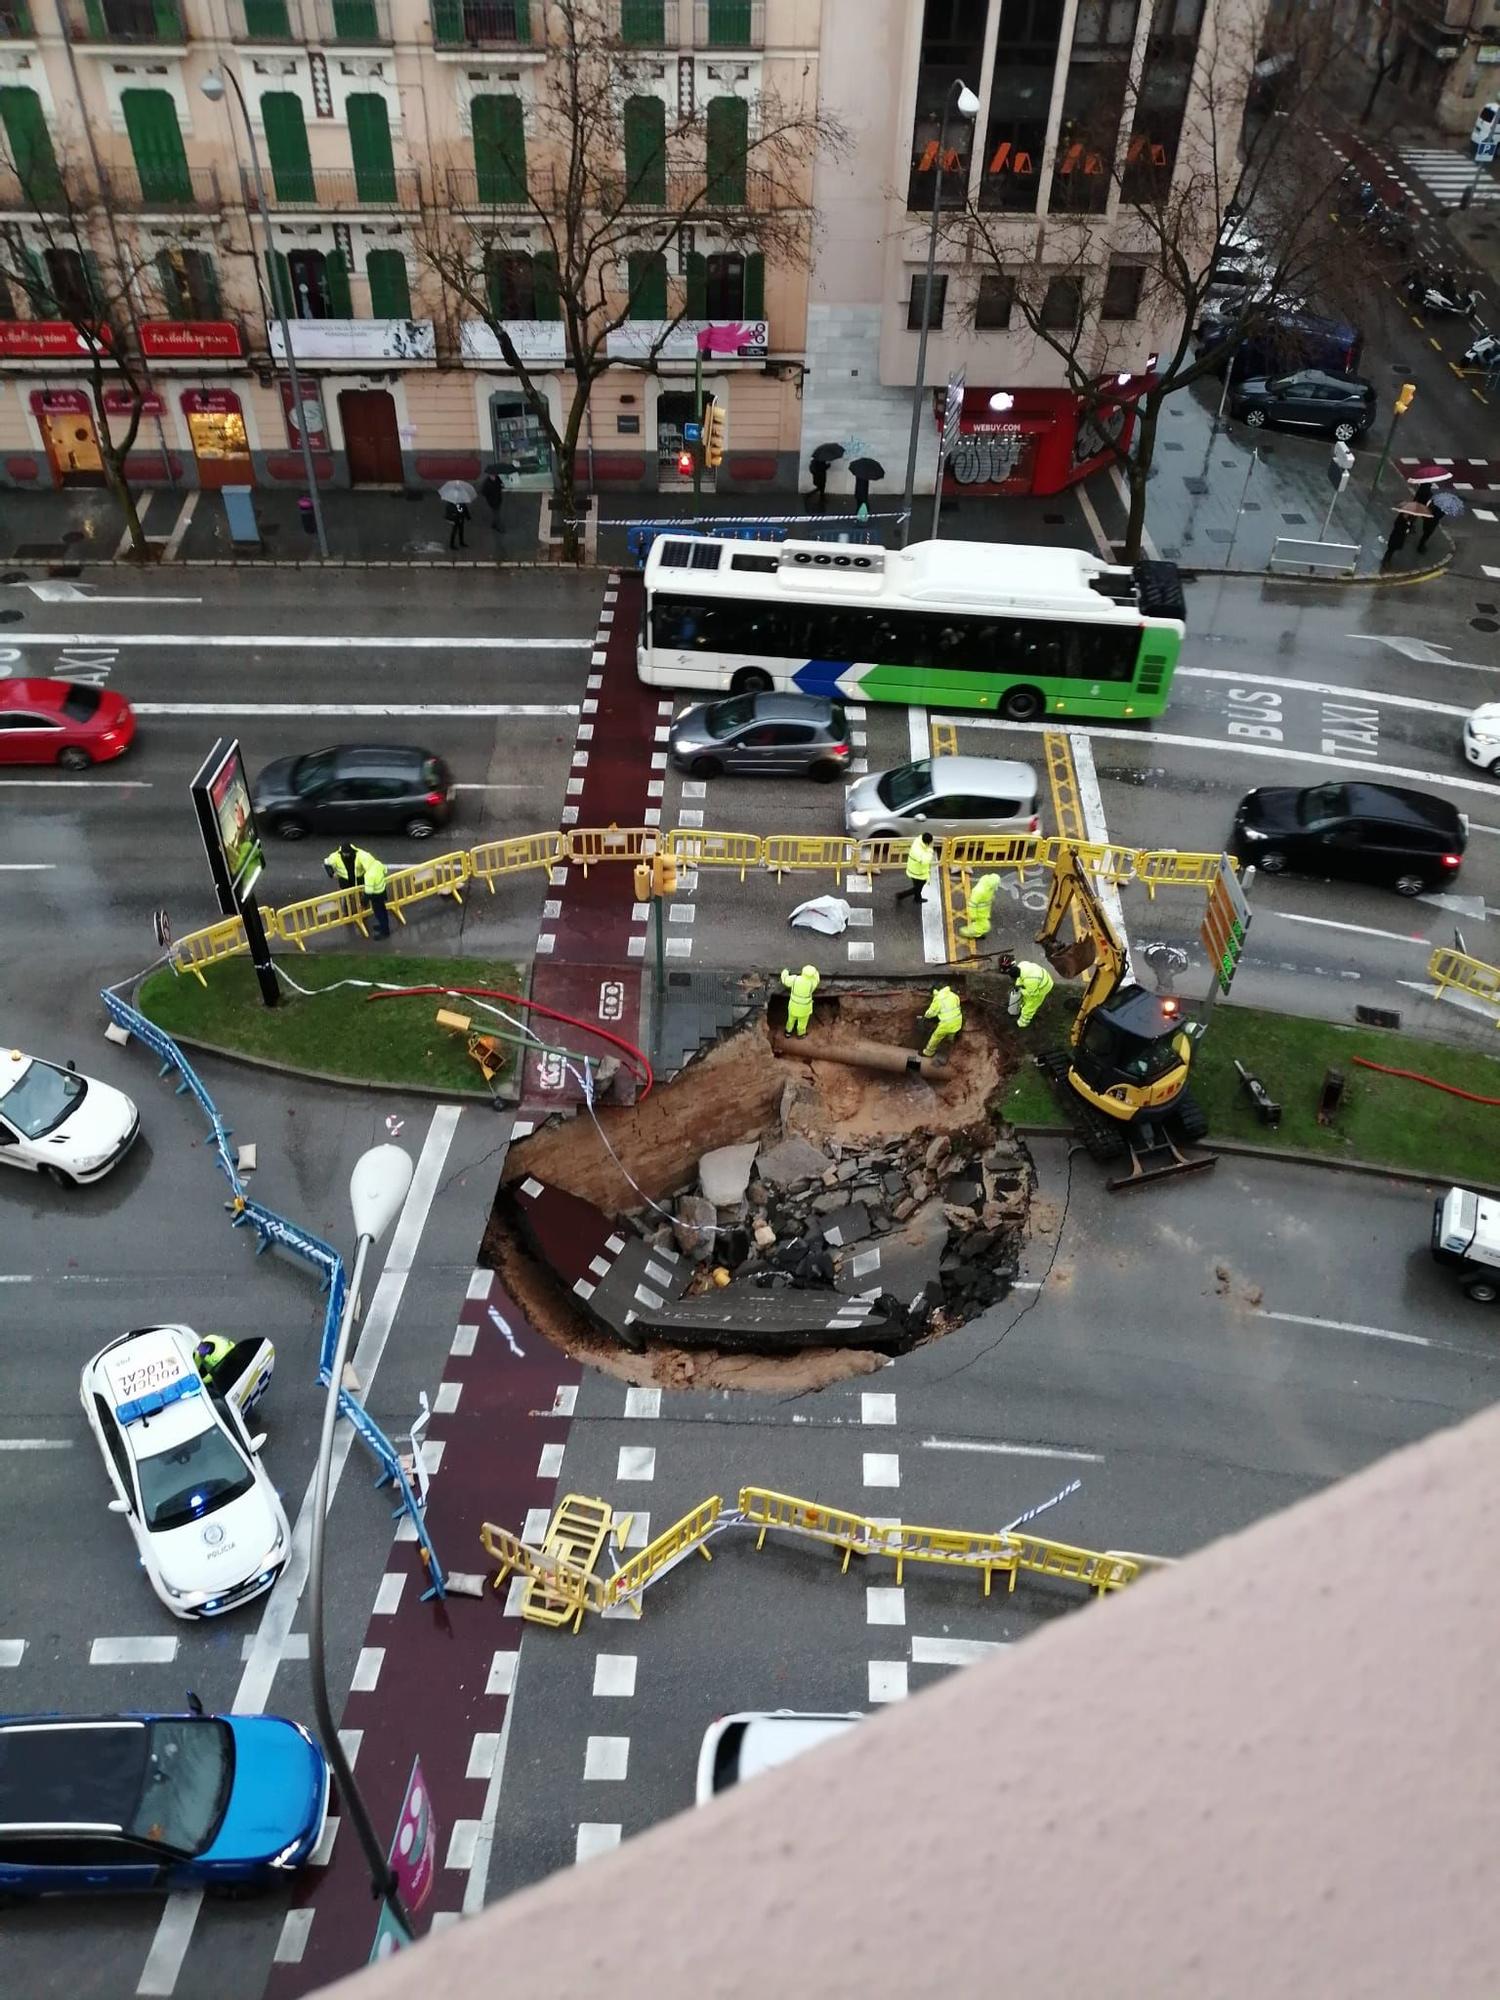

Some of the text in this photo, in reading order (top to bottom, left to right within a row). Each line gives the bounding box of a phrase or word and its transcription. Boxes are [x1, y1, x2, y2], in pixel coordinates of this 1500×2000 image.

[973, 423, 1021, 432] WEBUY.COM
[48, 648, 120, 687] AXI
[1228, 688, 1284, 742] BUS
[1321, 702, 1379, 756] TAXI
[118, 1360, 164, 1386] LOCAL
